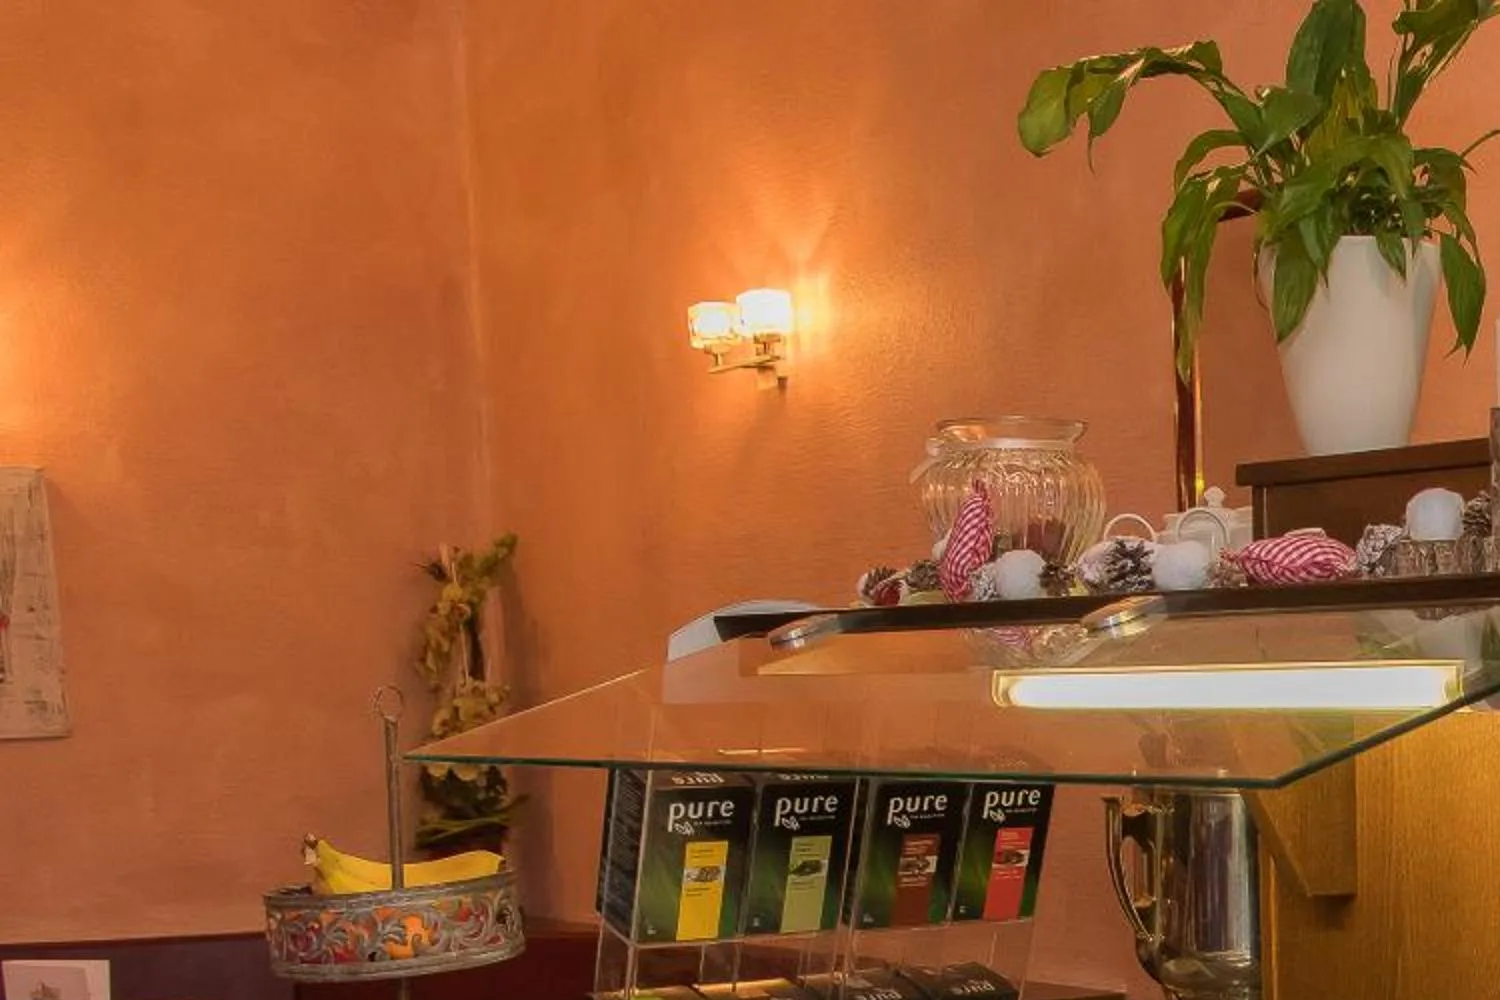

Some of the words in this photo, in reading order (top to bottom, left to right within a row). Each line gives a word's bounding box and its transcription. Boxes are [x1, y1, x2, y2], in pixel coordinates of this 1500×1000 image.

[667, 799, 735, 833] pure
[774, 794, 839, 828] pure
[886, 793, 948, 826] pure
[982, 788, 1041, 820] pure
